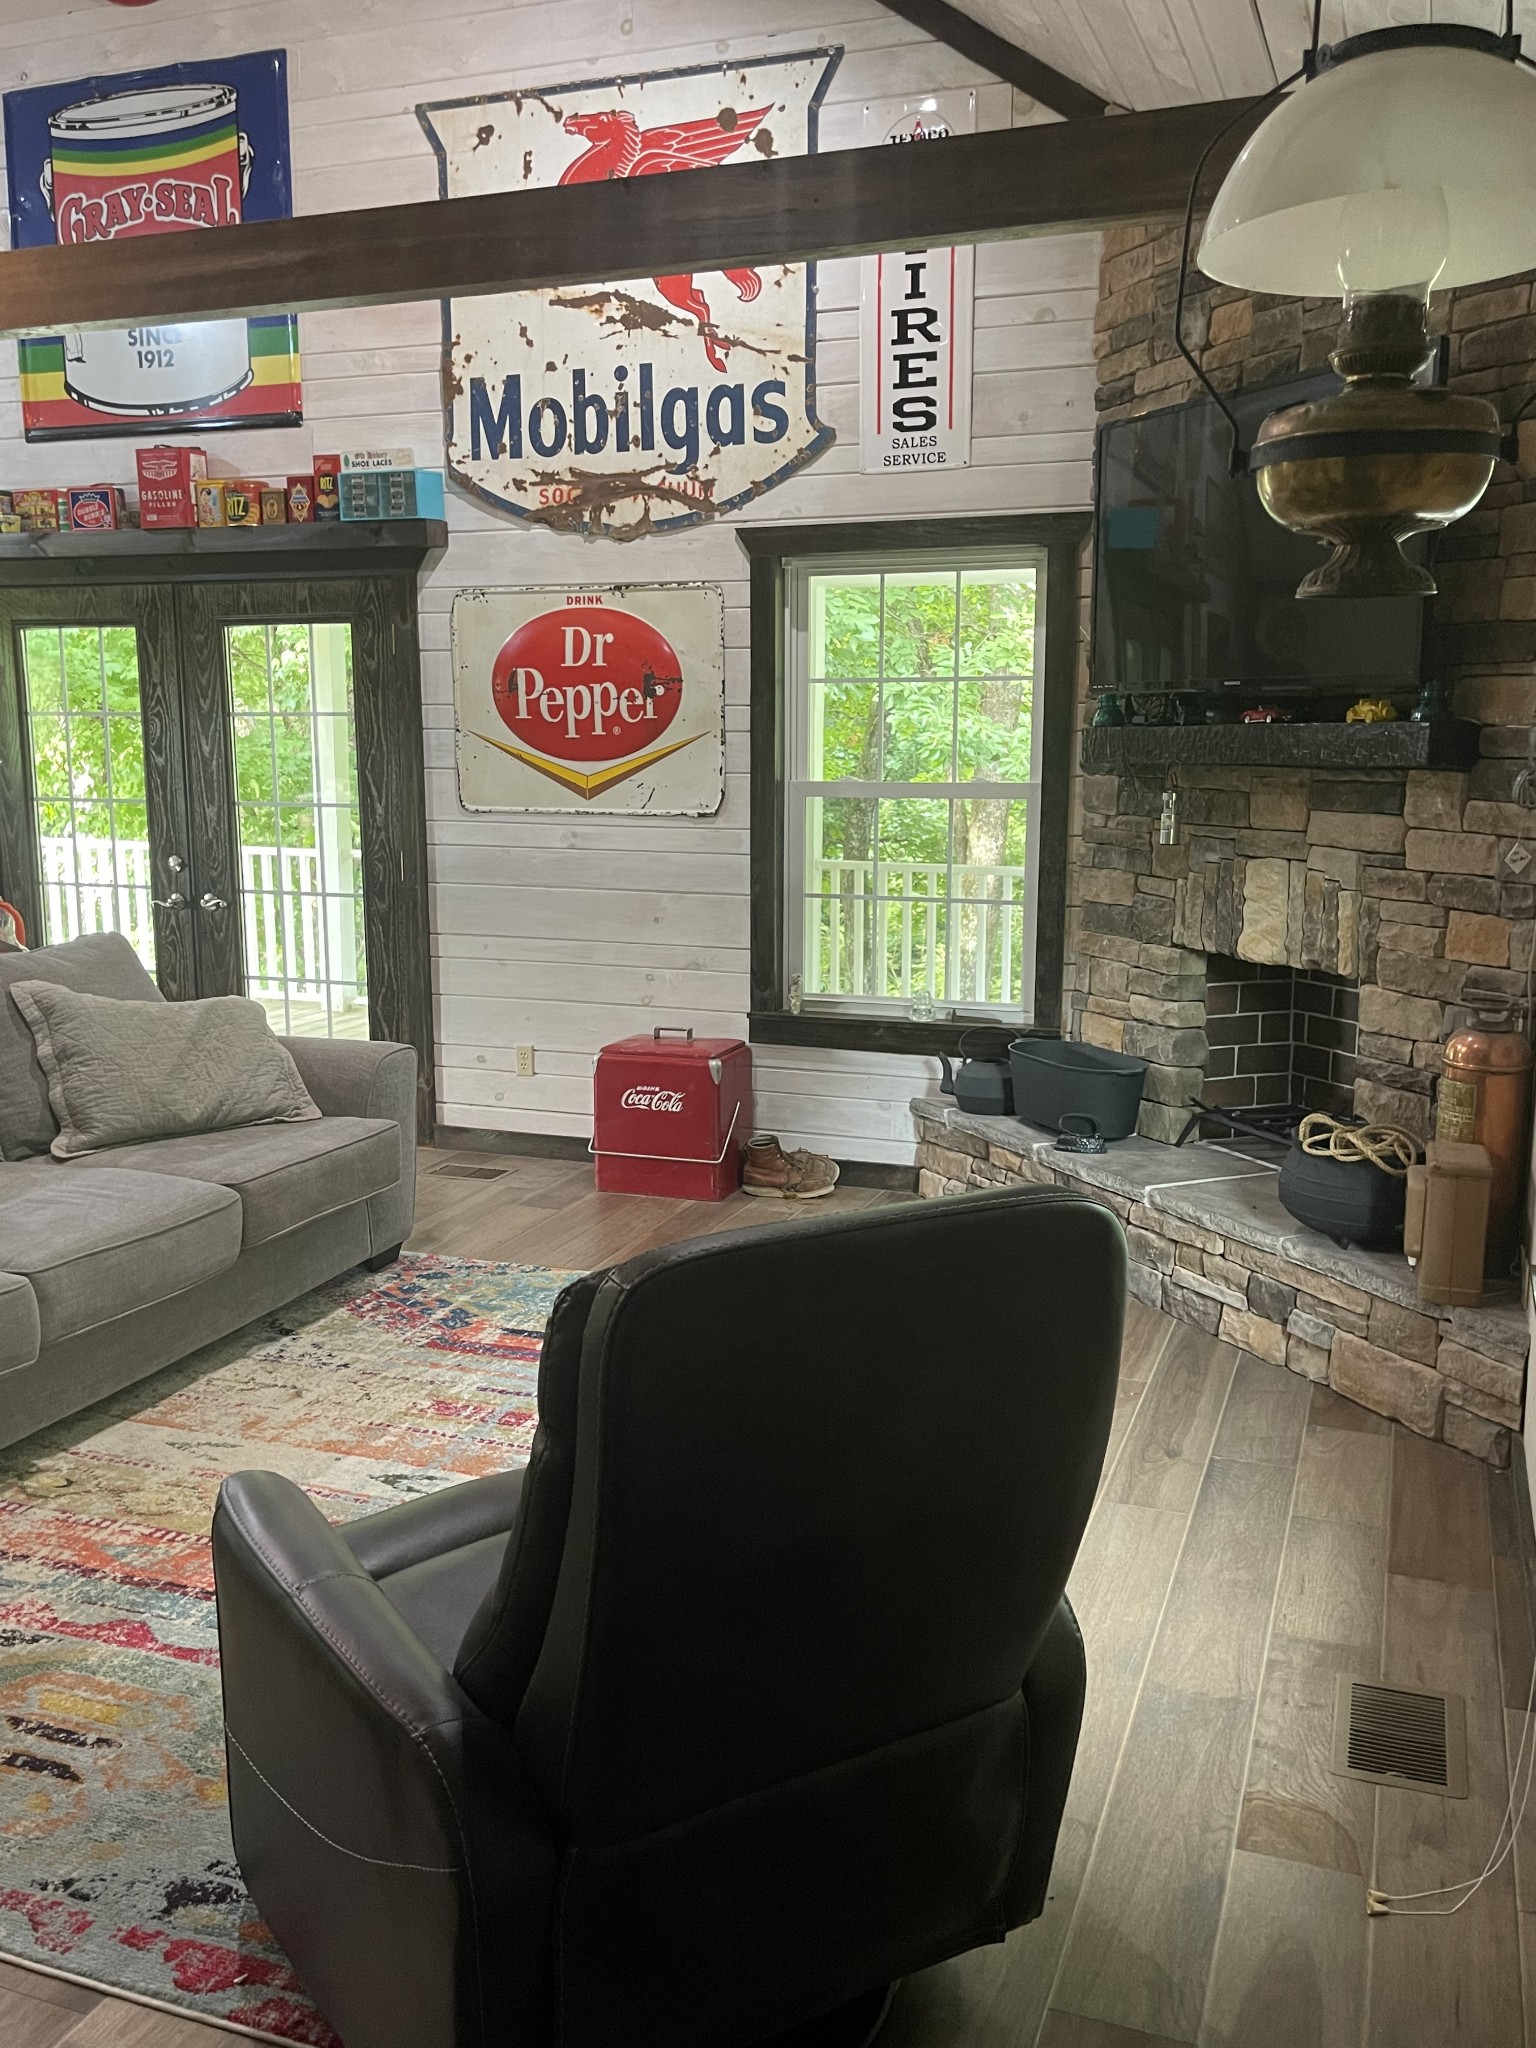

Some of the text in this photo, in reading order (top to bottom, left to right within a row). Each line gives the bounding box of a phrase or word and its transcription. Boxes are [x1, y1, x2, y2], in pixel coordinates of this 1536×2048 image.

[891, 249, 941, 433] IRES
[137, 348, 175, 369] 1912
[469, 362, 790, 476] Mobilgas
[892, 435, 937, 449] SALES
[351, 459, 393, 468] SHOE LACES
[883, 452, 947, 467] SERVICE
[319, 476, 334, 490] RITZ
[141, 489, 183, 501] GASOLINE
[566, 595, 604, 606] DRINK
[560, 626, 615, 667] Dr
[513, 667, 665, 739] Pepper
